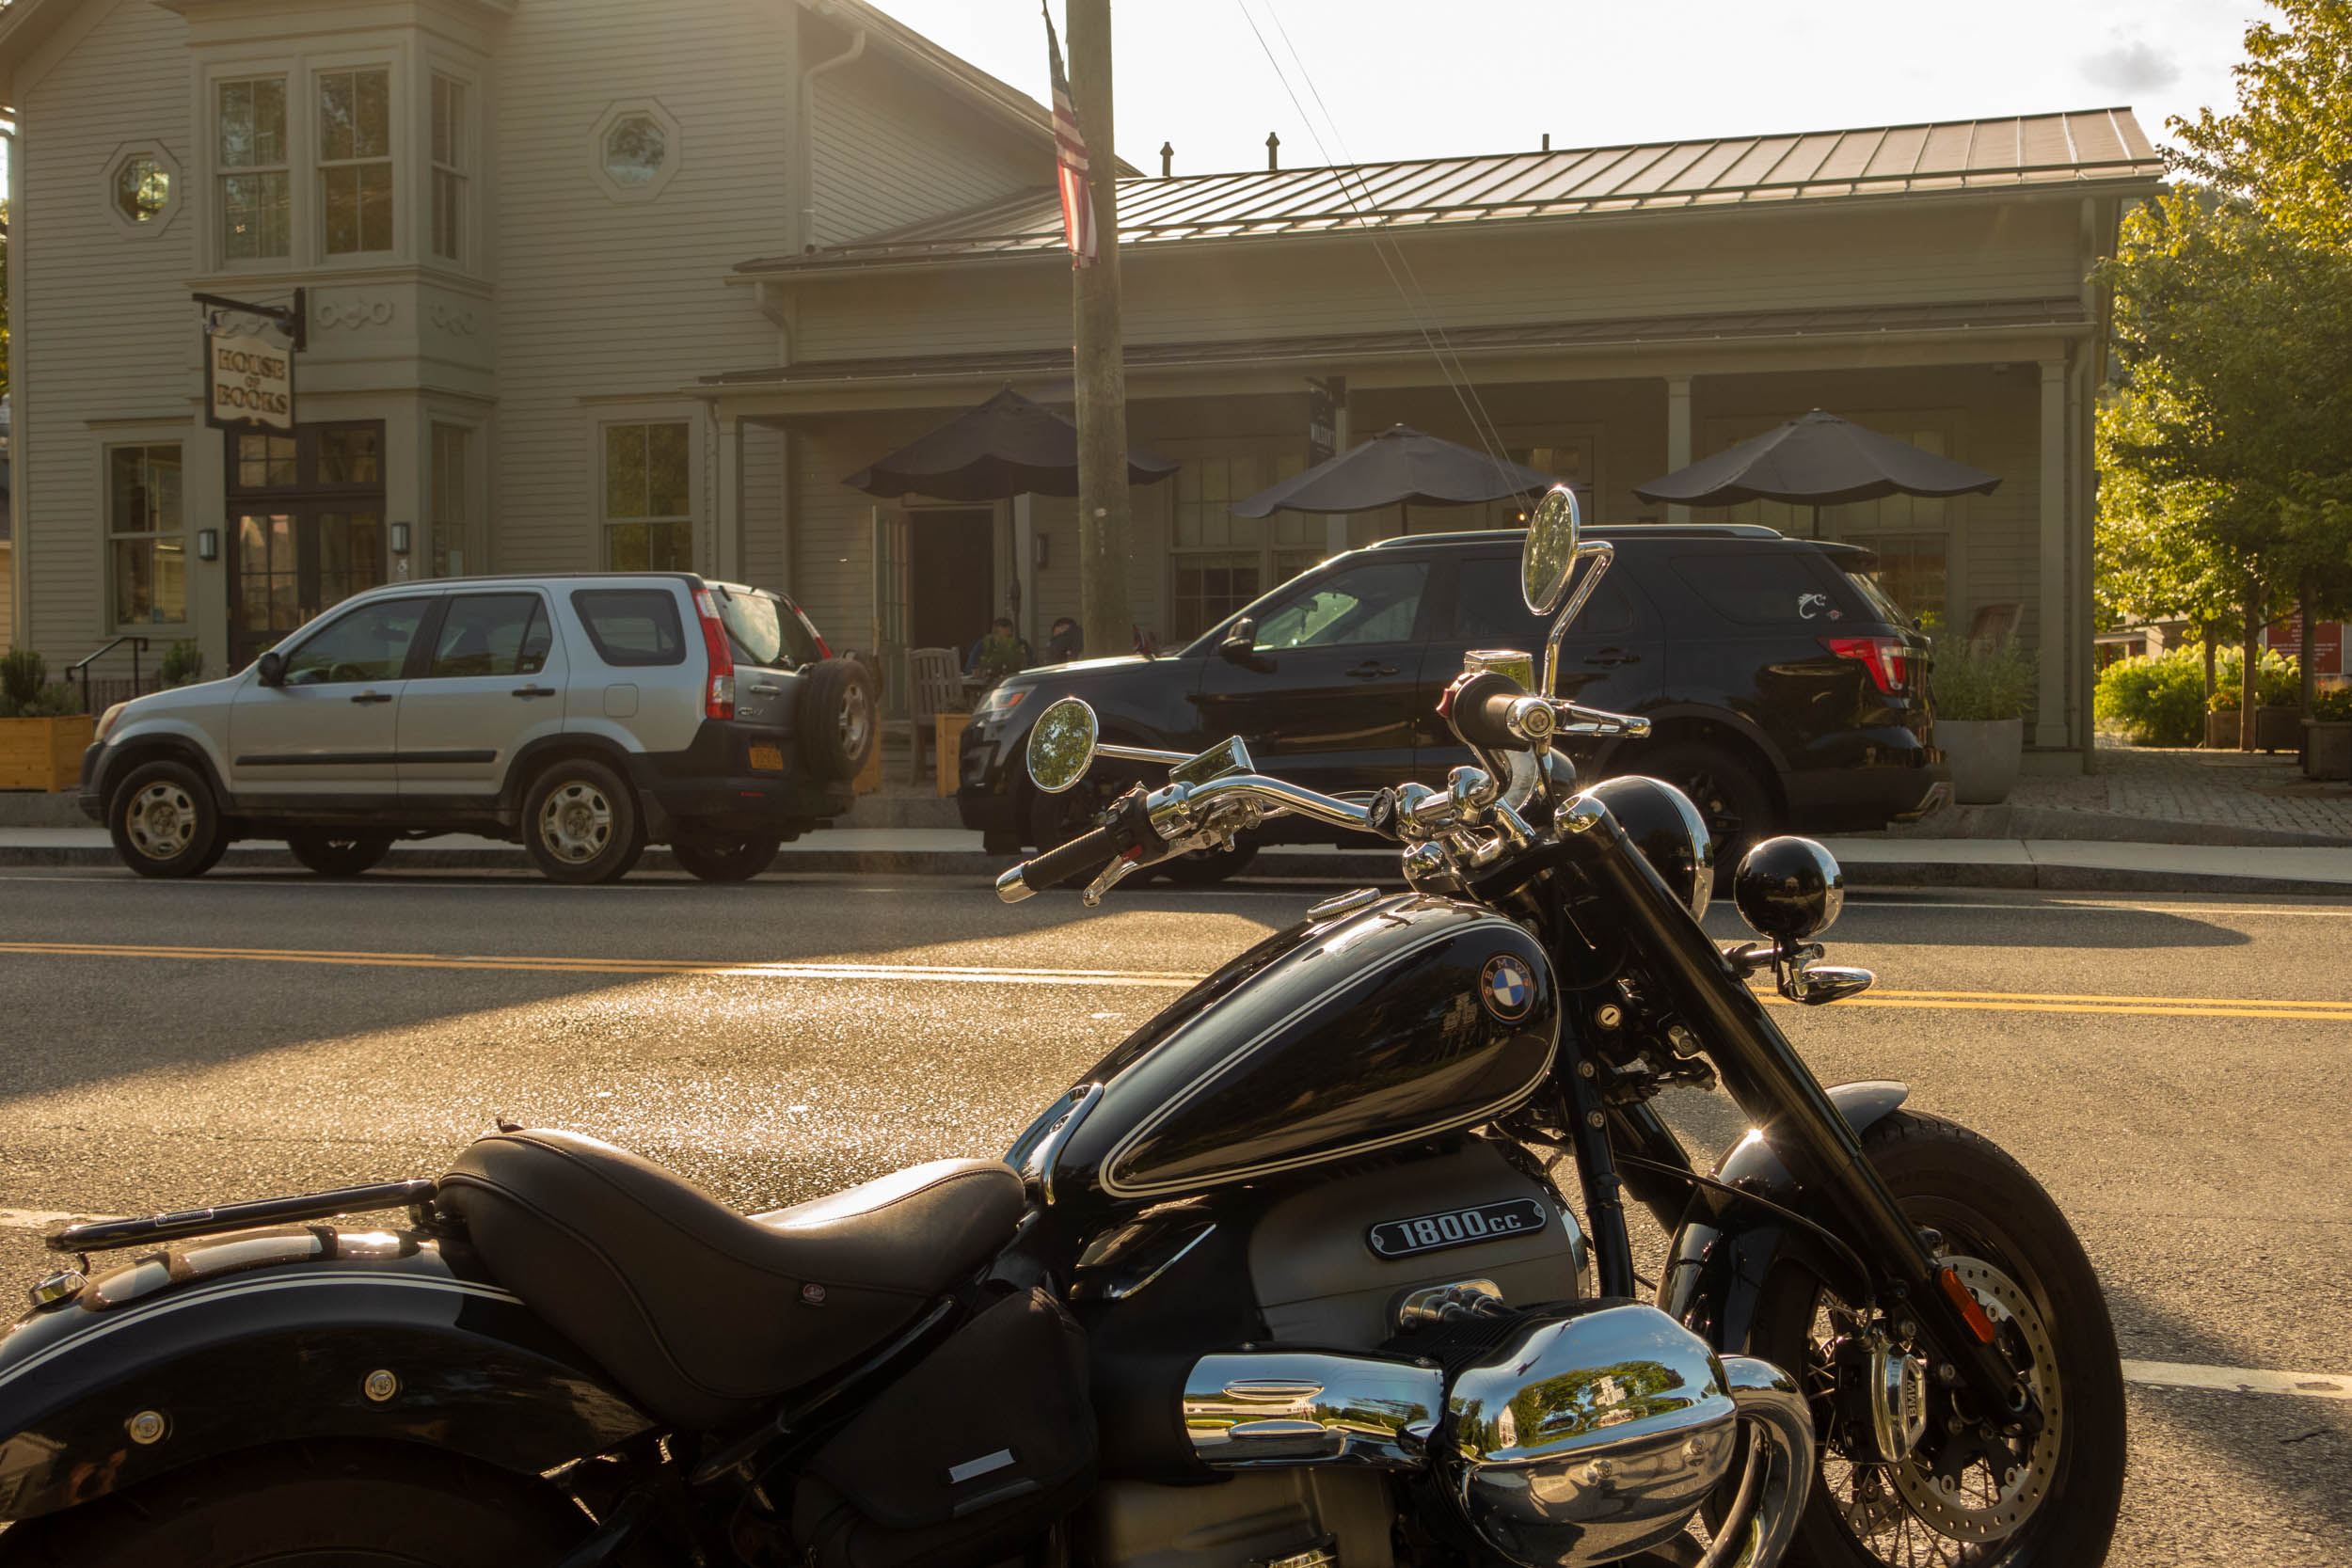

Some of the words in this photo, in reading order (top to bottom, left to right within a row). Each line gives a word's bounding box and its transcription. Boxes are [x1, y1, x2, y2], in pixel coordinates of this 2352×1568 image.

[217, 348, 285, 381] HOUSE
[216, 384, 288, 415] BOOKS
[1485, 959, 1528, 980] BMW
[1397, 1211, 1521, 1247] 1800cc
[1907, 1379, 1917, 1418] BMW
